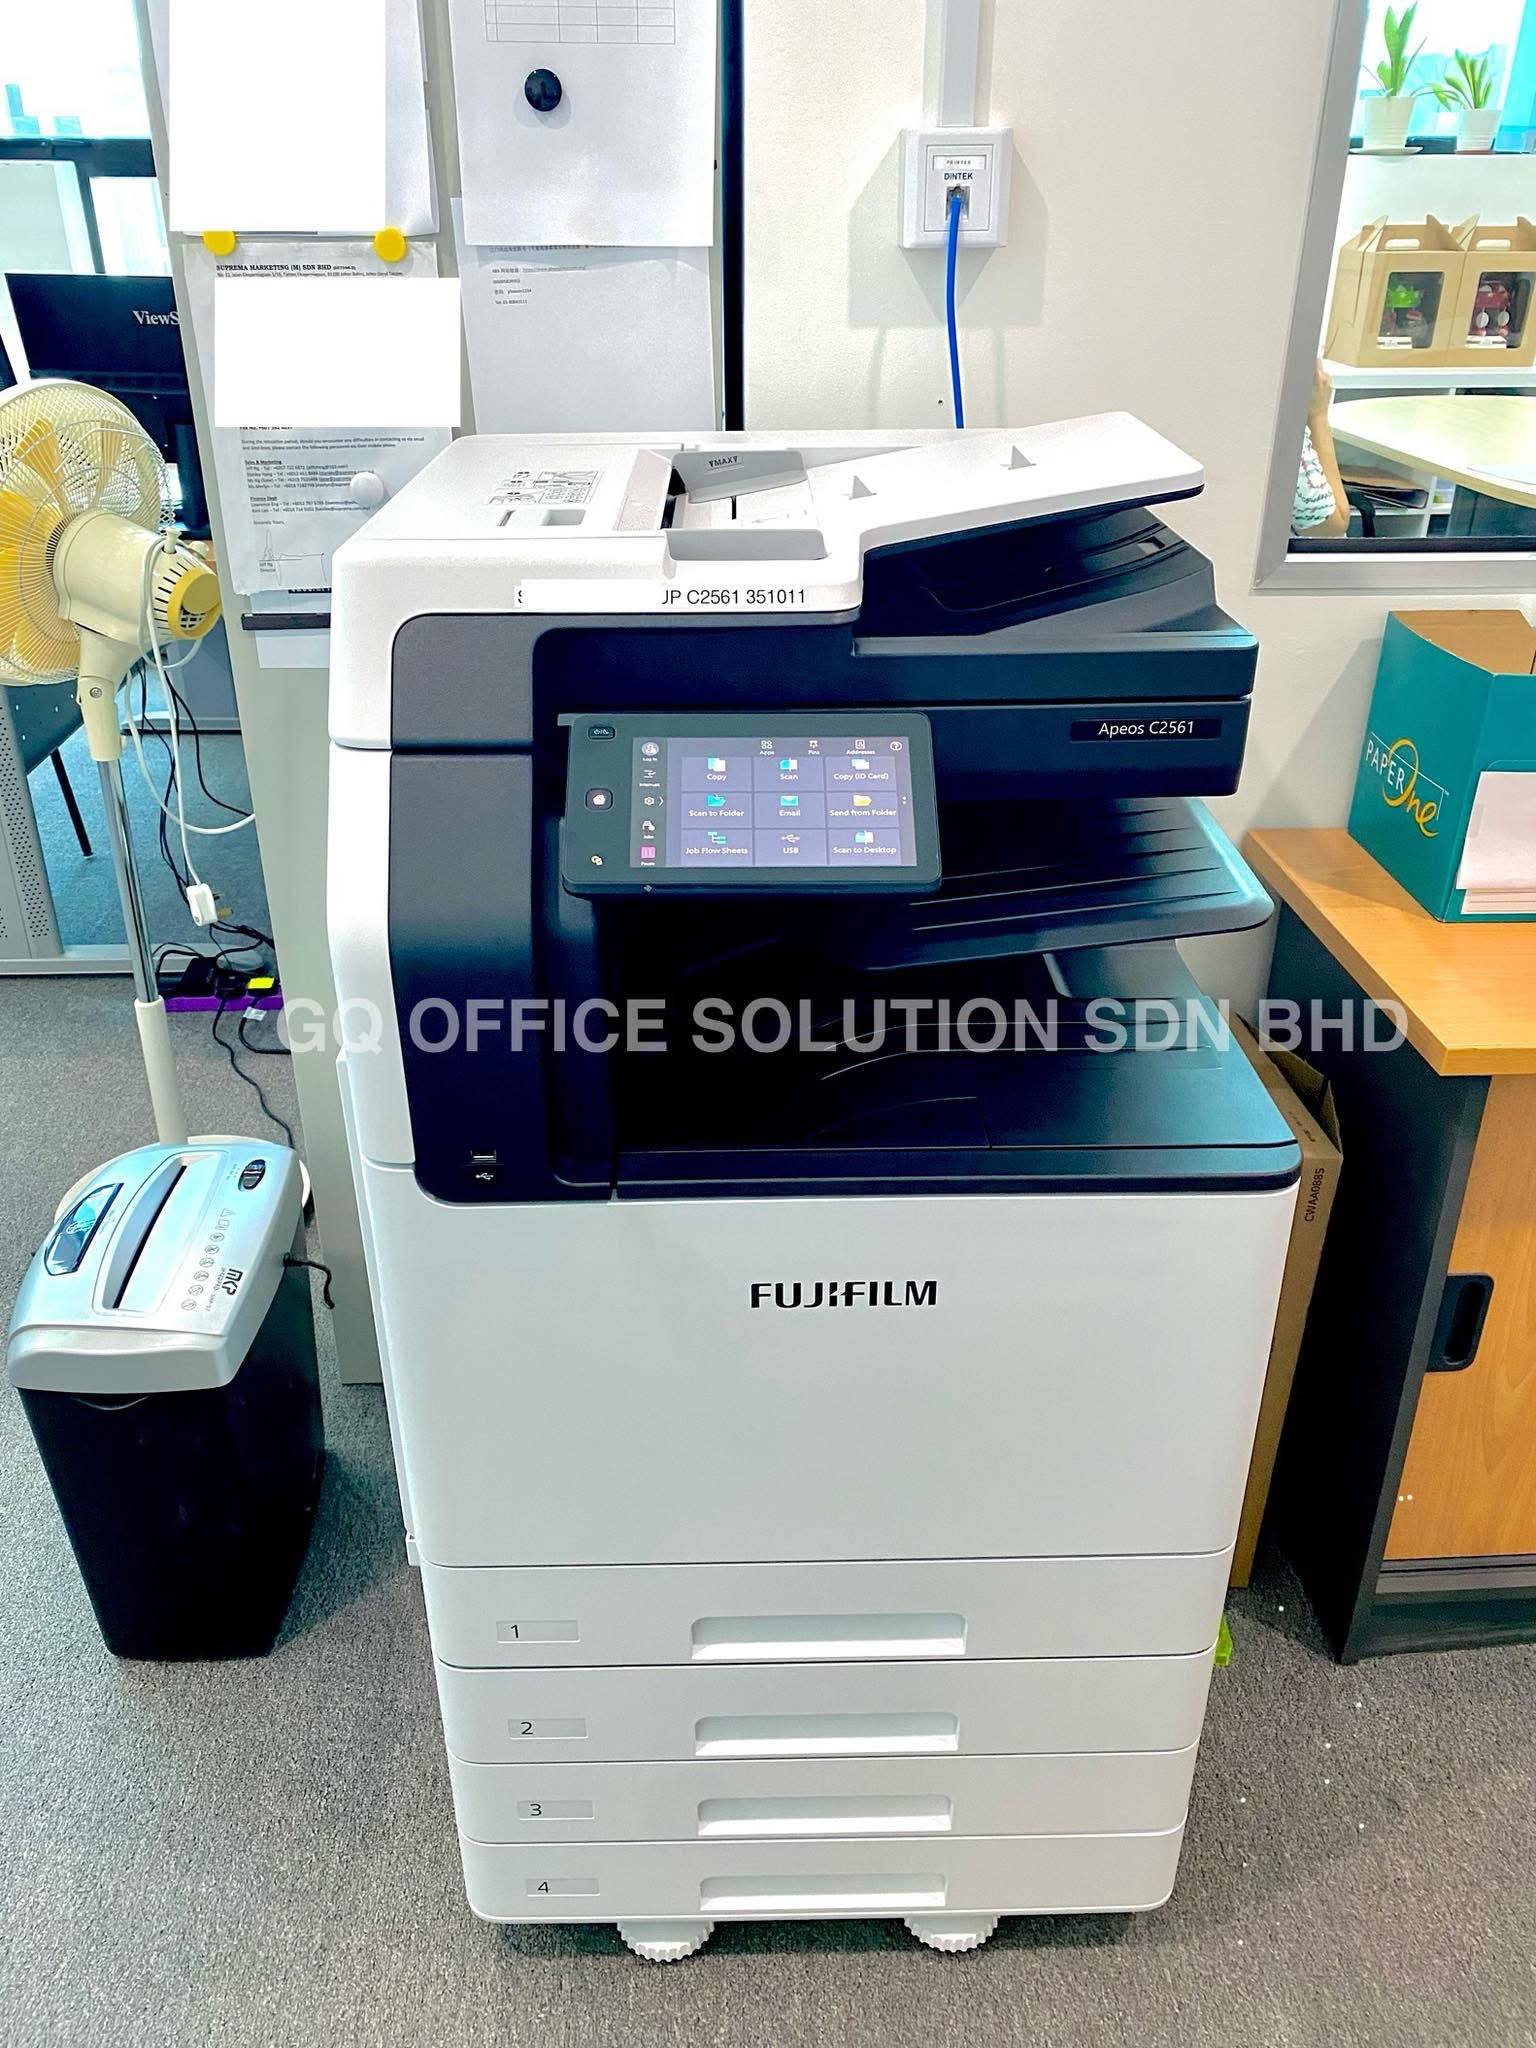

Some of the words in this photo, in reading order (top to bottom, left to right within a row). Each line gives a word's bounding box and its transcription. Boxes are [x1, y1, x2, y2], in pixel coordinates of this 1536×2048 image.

[944, 172, 973, 180] DINTEK
[687, 588, 739, 605] C2561
[745, 588, 806, 605] 351011
[1098, 723, 1145, 739] Apeos
[1149, 720, 1194, 735] C2561
[1366, 739, 1406, 794] PAPER
[706, 773, 727, 781] Copy
[833, 773, 854, 781] Copy
[867, 772, 889, 780] Card)
[1382, 738, 1440, 838] One
[779, 809, 801, 817] Email
[685, 847, 700, 855] Job
[832, 846, 852, 854] Scan
[863, 845, 897, 854] Desktop
[1304, 1167, 1325, 1222] CWAA0885
[750, 1280, 938, 1308] FUJIFILM
[510, 1624, 519, 1638] 1
[520, 1721, 534, 1735] 2
[529, 1803, 542, 1816] 3
[537, 1881, 550, 1893] 4
